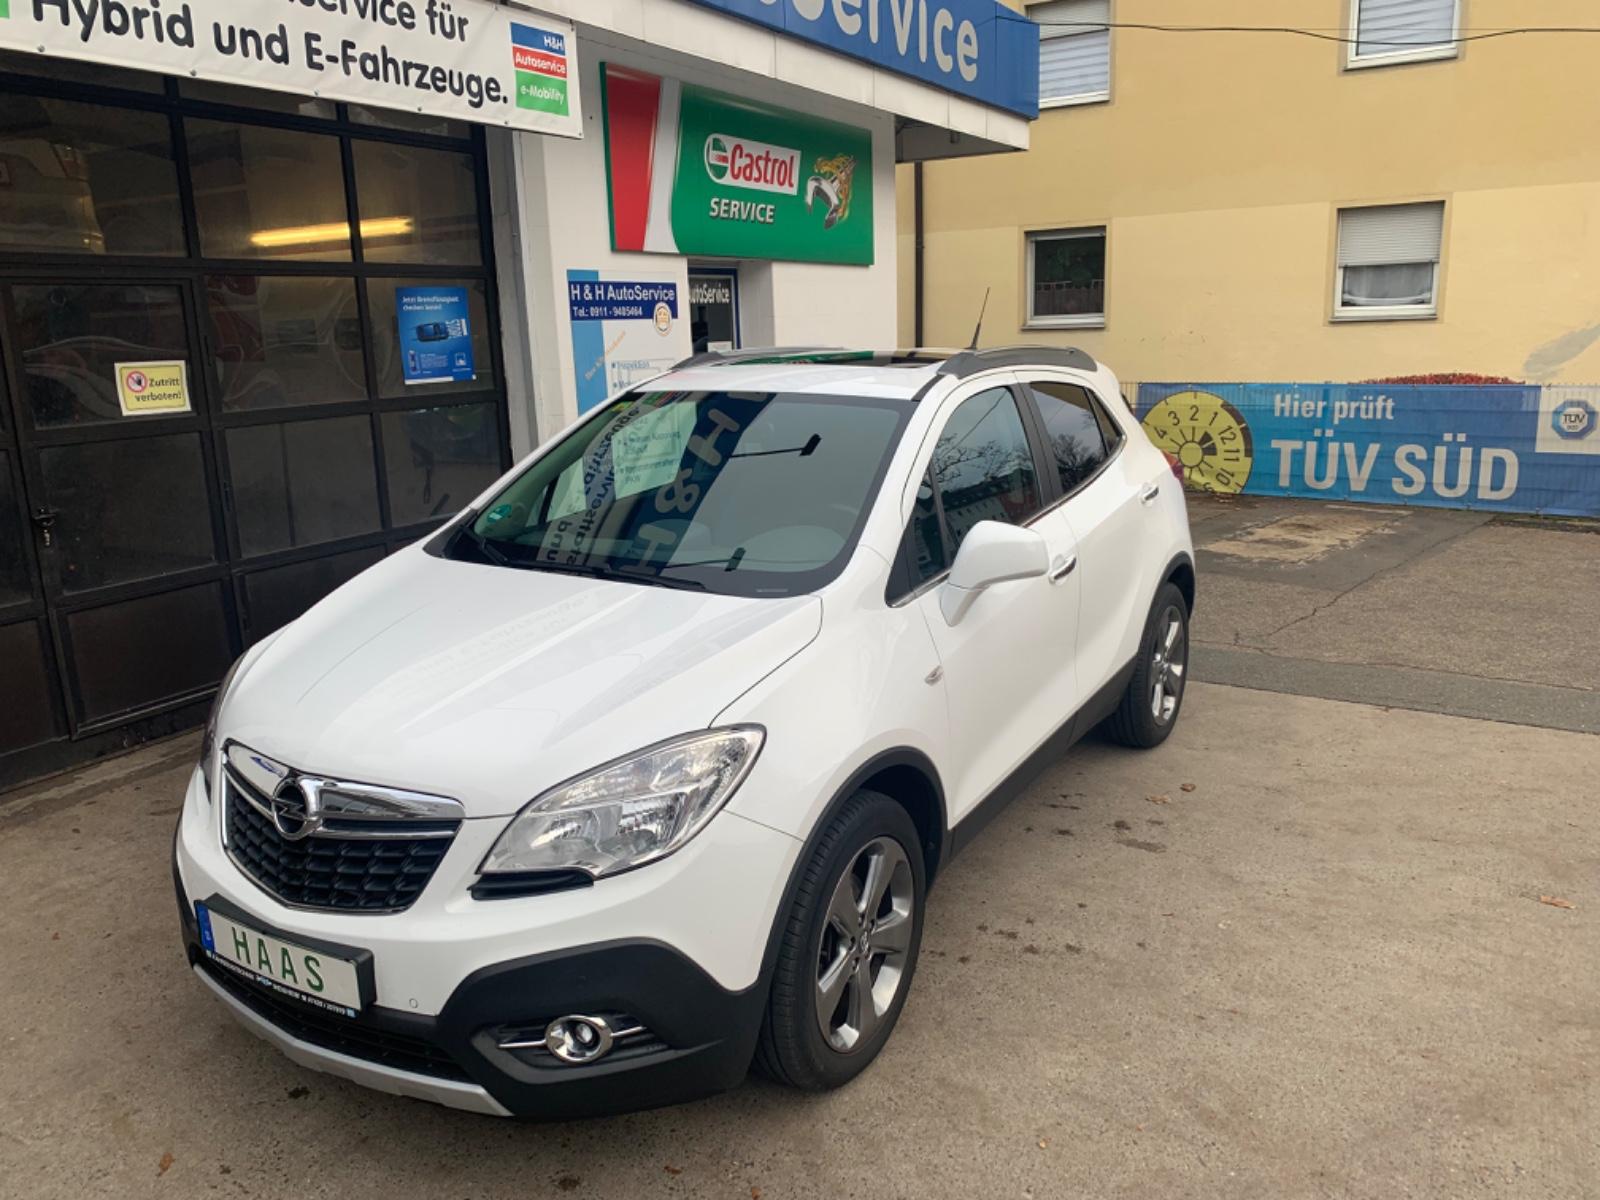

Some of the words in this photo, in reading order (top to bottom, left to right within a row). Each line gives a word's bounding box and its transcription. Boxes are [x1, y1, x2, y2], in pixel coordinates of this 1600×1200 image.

[426, 2, 469, 42] für
[543, 34, 564, 52] H&H
[213, 22, 290, 66] und
[304, 31, 509, 108] E-Fahrzeuge.
[515, 52, 566, 74] Autoservice
[520, 85, 565, 105] e-Mobility
[729, 143, 795, 188] Castrol
[709, 197, 776, 223] SERVICE
[570, 284, 580, 300] H
[583, 284, 593, 300] &
[595, 285, 604, 301] H
[607, 284, 675, 301] AutoService
[148, 377, 180, 388] Zutritt
[135, 391, 182, 402] verboten!
[1167, 410, 1180, 427] 3
[1189, 404, 1200, 421] 2
[1274, 393, 1327, 418] Hier
[1333, 395, 1395, 425] prüft
[1154, 425, 1167, 439] 4
[1218, 425, 1237, 446] 12
[1223, 448, 1240, 463] 11
[1270, 428, 1381, 492] TÜV
[1391, 432, 1519, 500] SÜD
[1215, 467, 1236, 487] 10
[232, 926, 325, 993] HAAS
